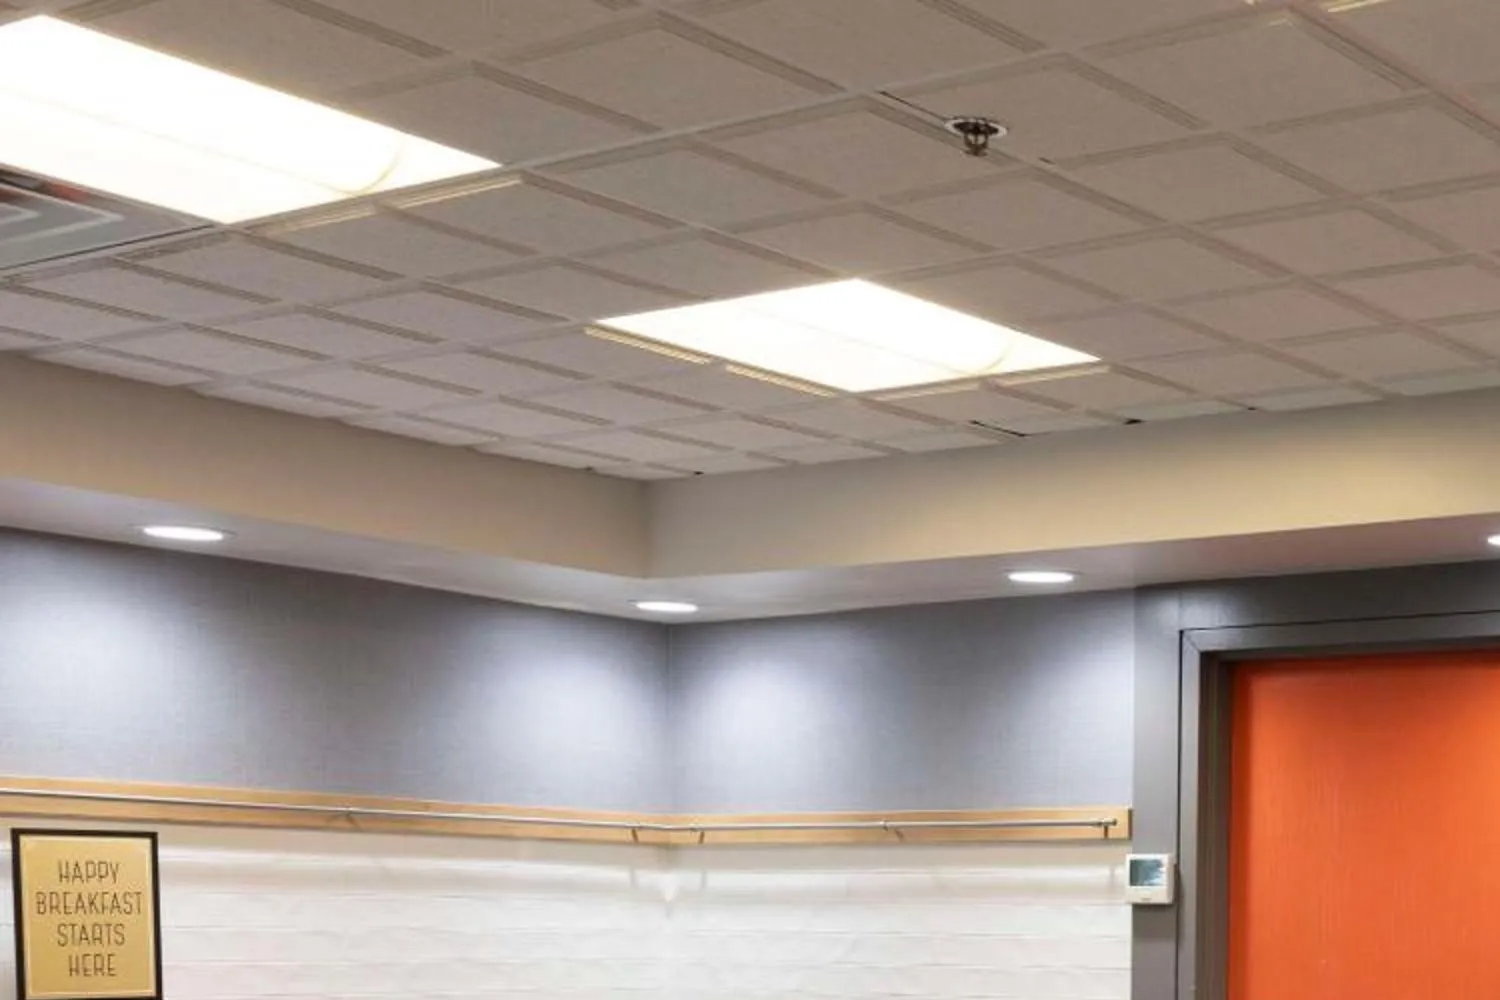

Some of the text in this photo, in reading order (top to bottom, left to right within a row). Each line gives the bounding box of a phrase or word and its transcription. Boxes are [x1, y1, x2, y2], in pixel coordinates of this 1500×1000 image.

[57, 859, 120, 884] HAPPY
[35, 891, 143, 916] BREAKFAST
[56, 923, 126, 947] STARTS
[68, 953, 118, 978] HERE
